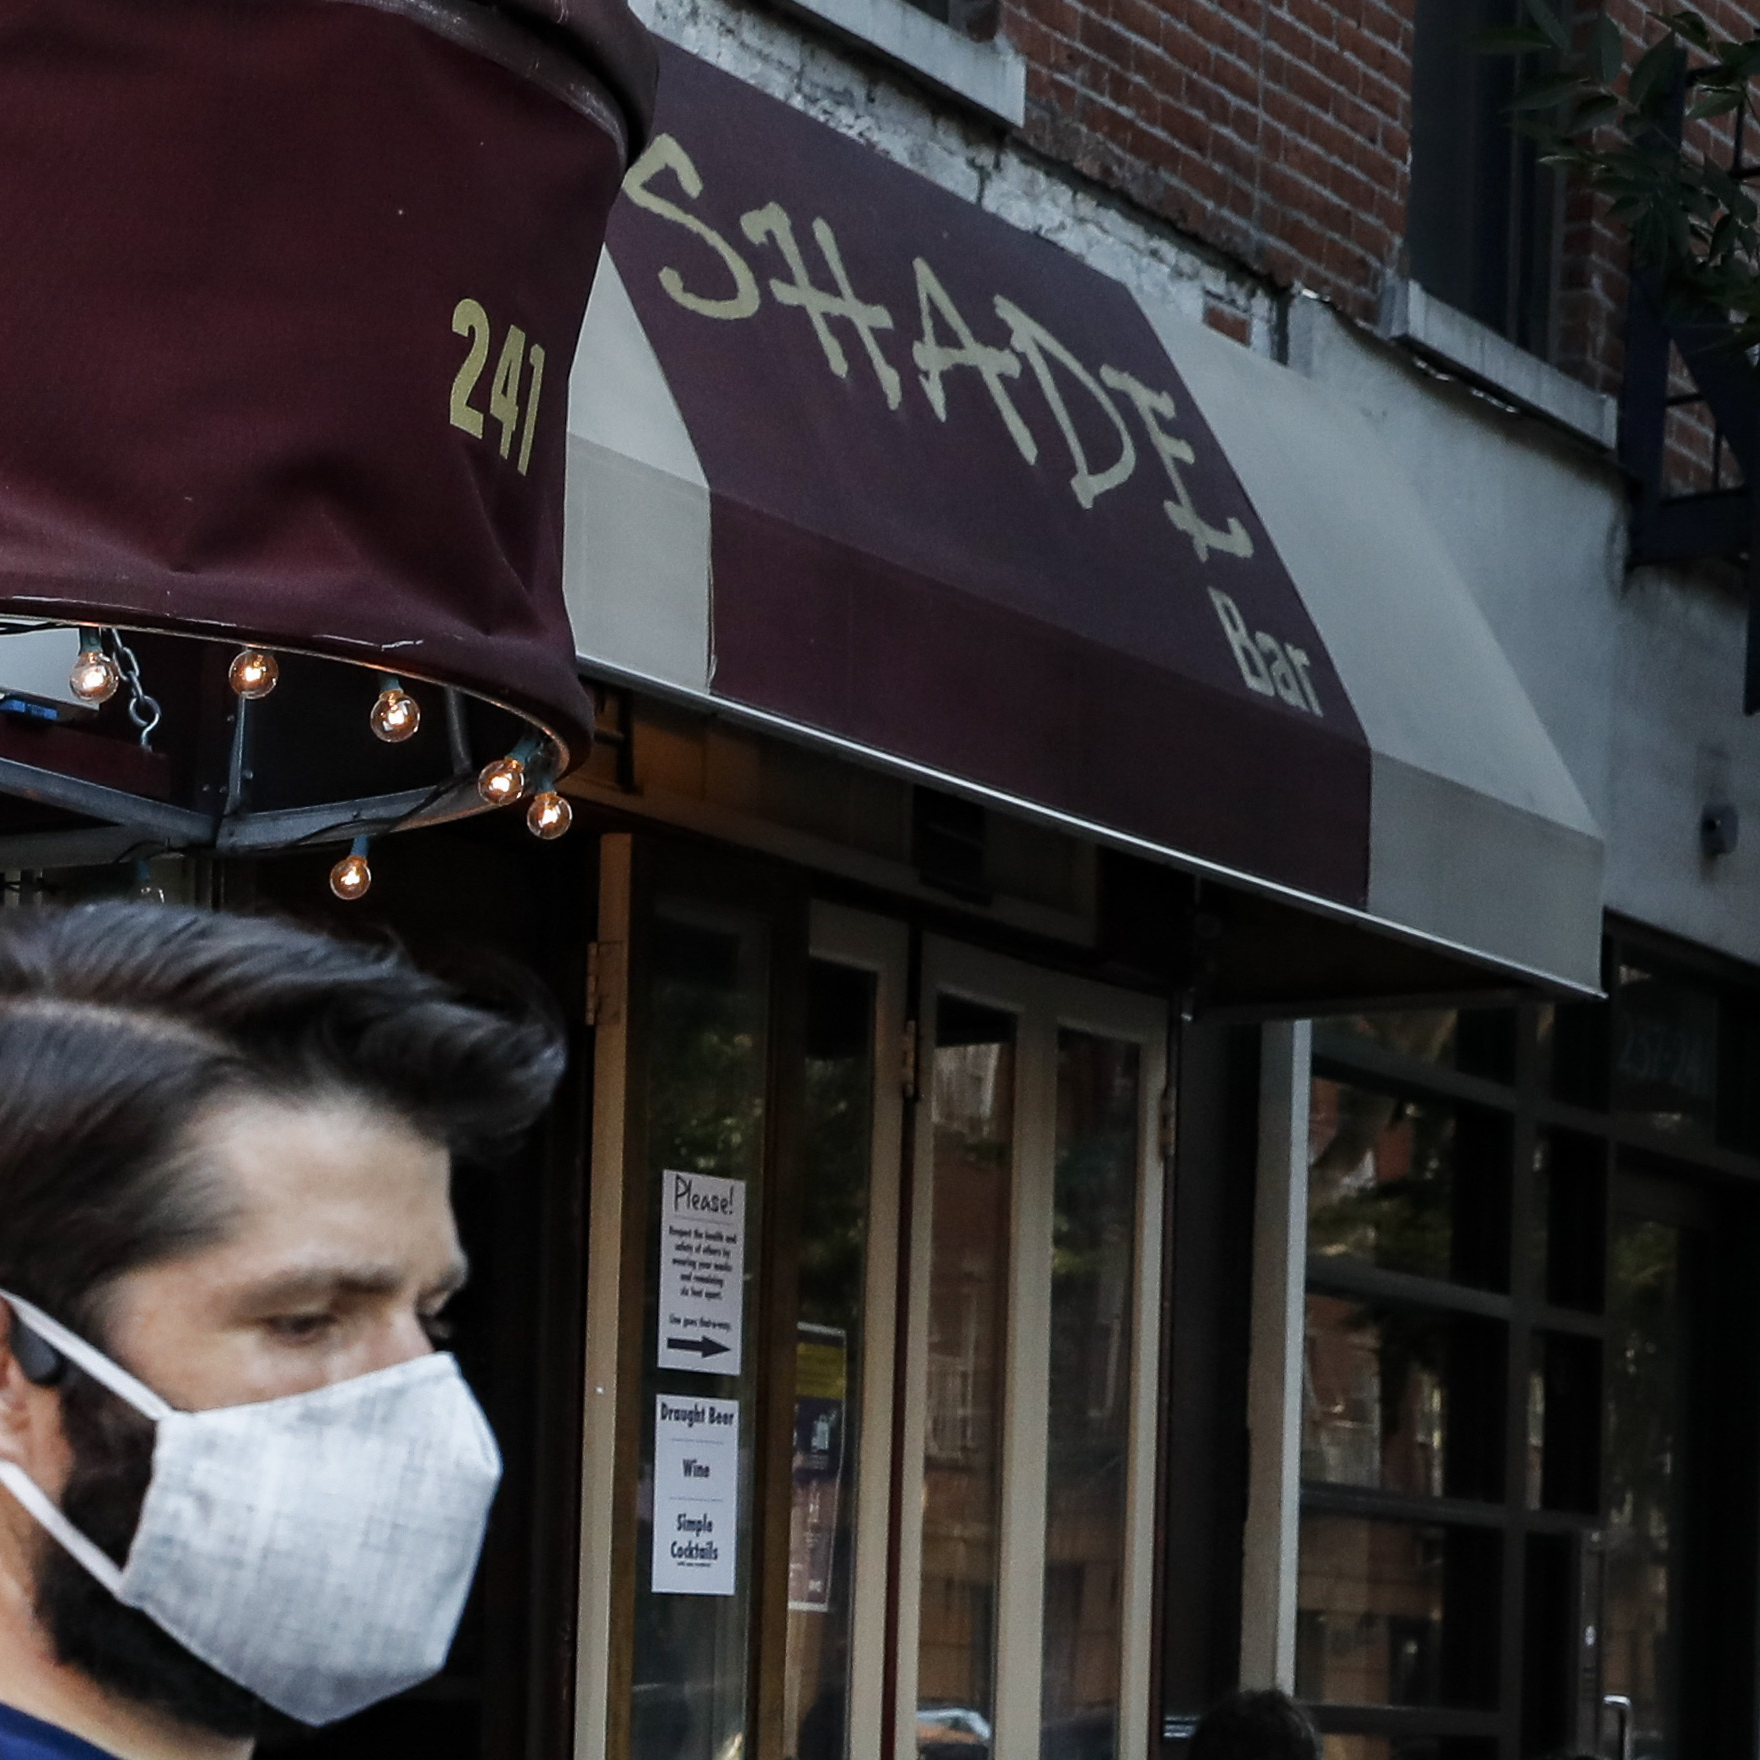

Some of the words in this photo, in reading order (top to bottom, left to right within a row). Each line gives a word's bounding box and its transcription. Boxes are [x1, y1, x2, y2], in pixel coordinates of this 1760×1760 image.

[625, 132, 1254, 561] SHADE
[449, 298, 545, 477] 241
[1207, 586, 1322, 716] Bar
[675, 1173, 734, 1215] Please!
[660, 1401, 705, 1428] Draught
[708, 1406, 734, 1426] Beer
[682, 1458, 710, 1478] Wine
[677, 1513, 713, 1537] Simple
[670, 1540, 718, 1561] Cocktails
